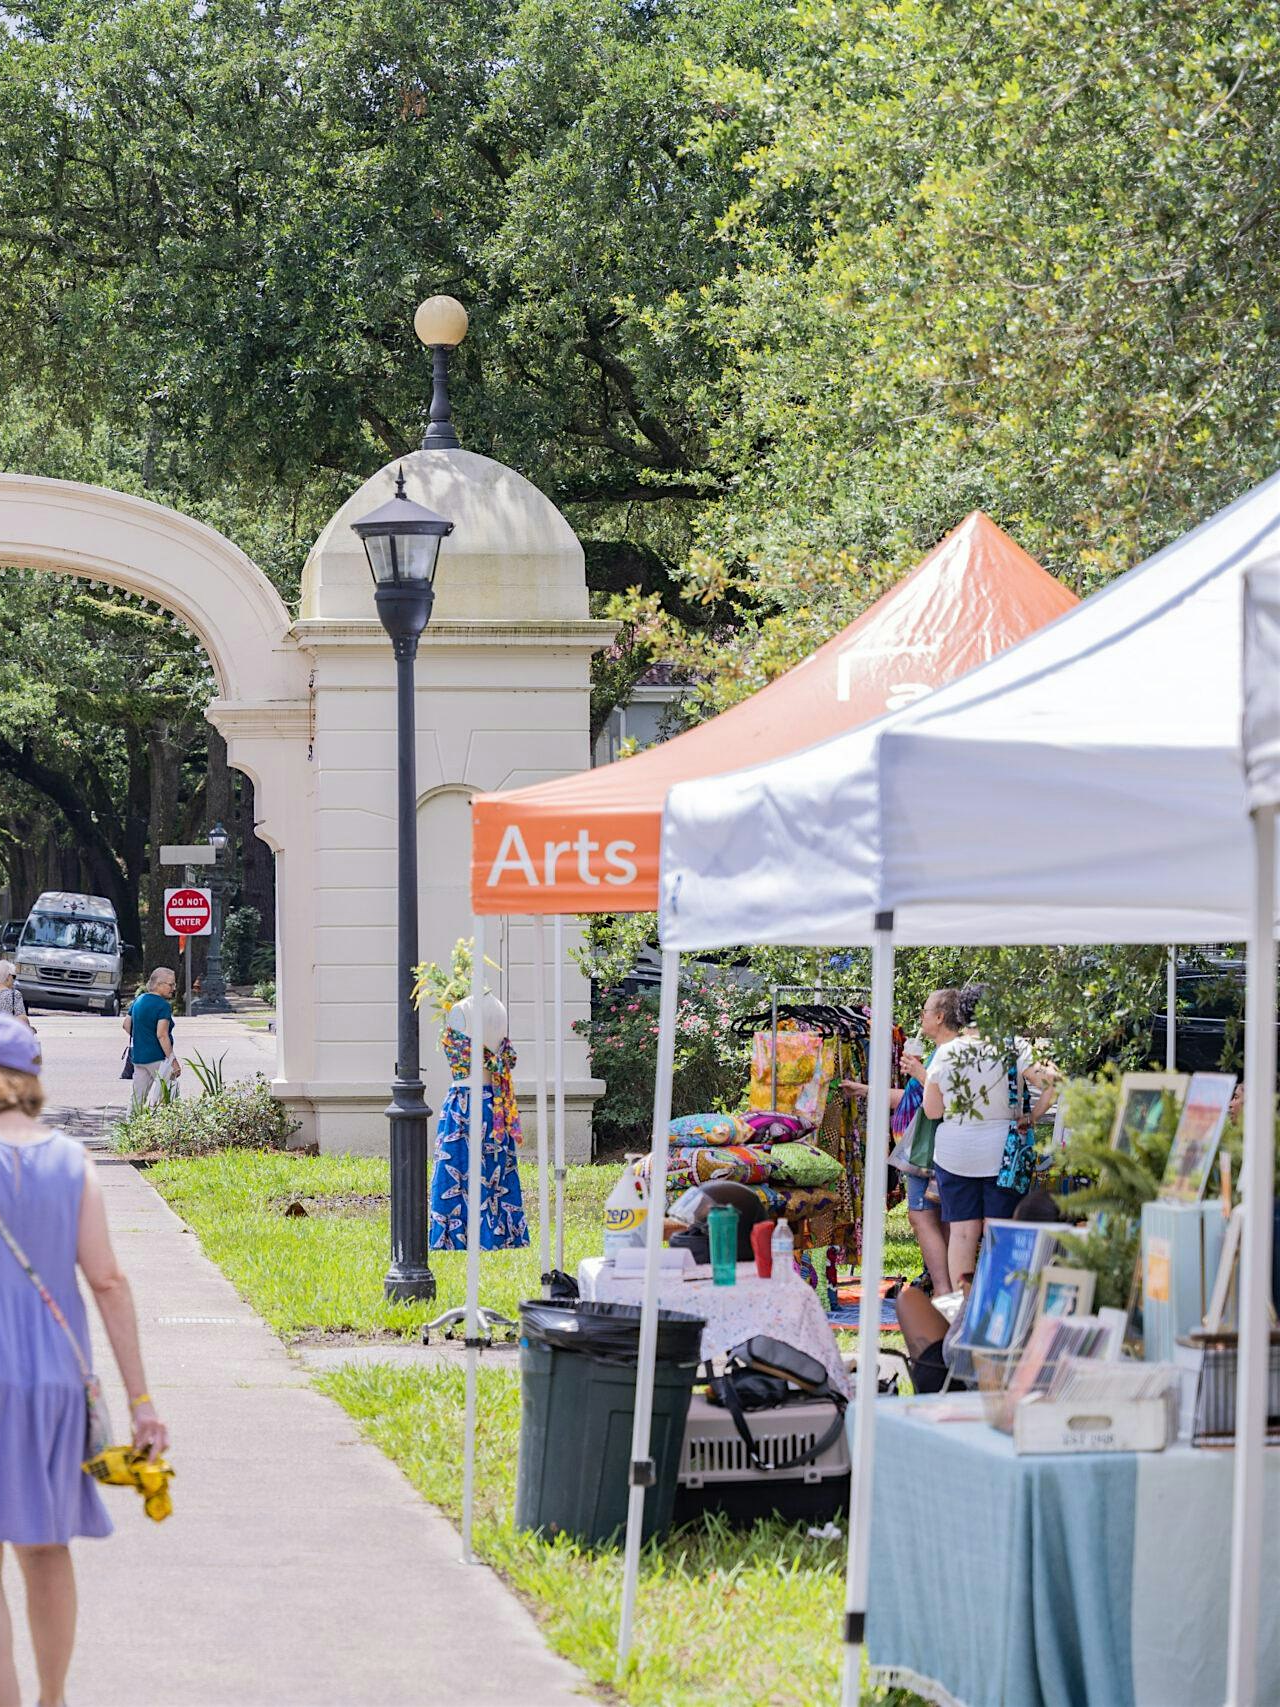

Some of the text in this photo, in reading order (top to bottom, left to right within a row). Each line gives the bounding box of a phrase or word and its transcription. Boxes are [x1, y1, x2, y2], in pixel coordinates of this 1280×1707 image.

[486, 825, 638, 887] Arts
[171, 898, 204, 906] DO NOT
[175, 918, 201, 926] ENTER
